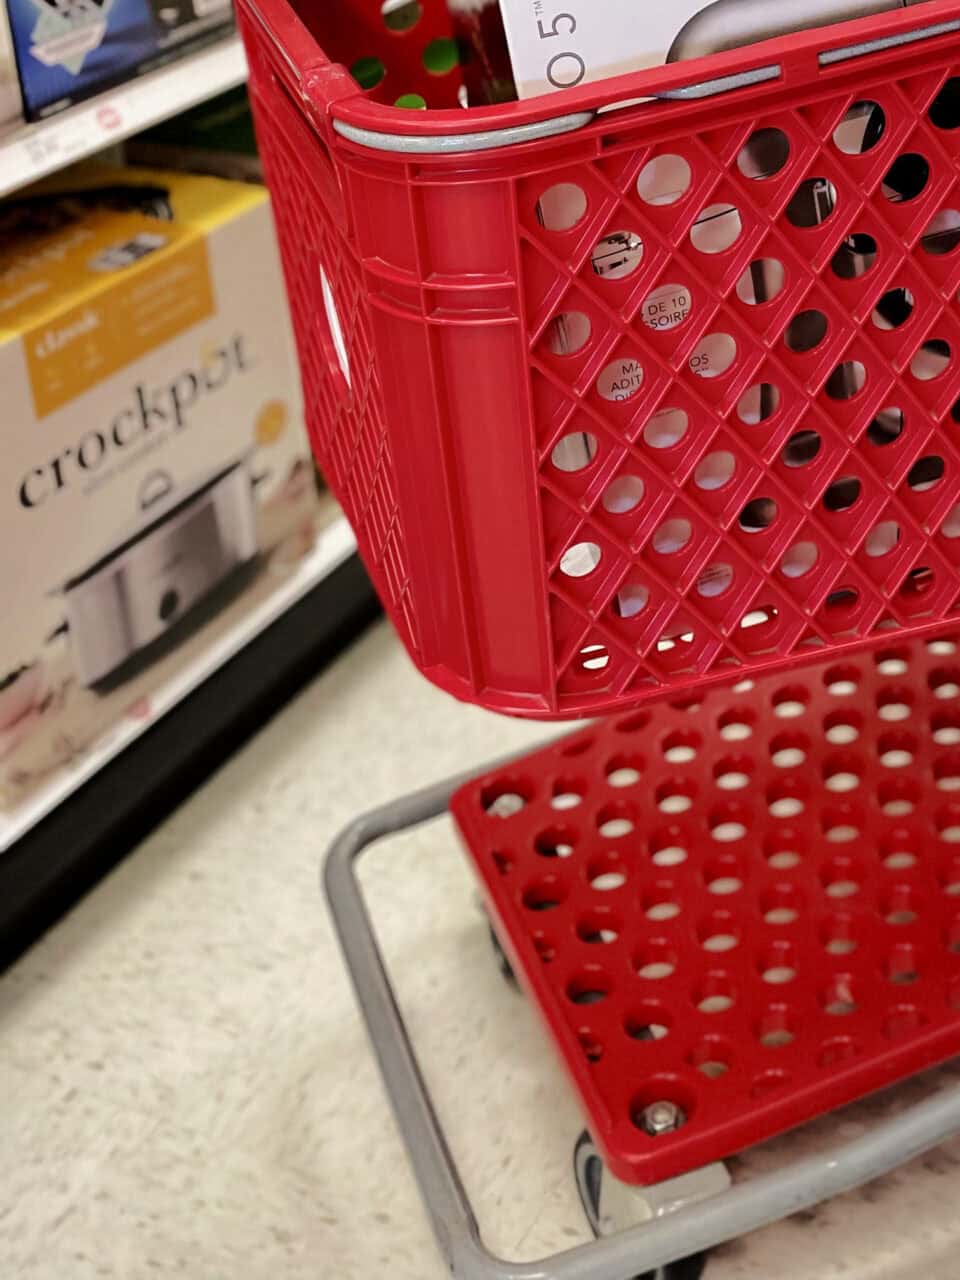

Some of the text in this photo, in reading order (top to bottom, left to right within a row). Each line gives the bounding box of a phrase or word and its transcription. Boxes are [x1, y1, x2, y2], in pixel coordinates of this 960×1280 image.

[648, 296, 687, 316] DE 10
[18, 329, 252, 511] crockpot
